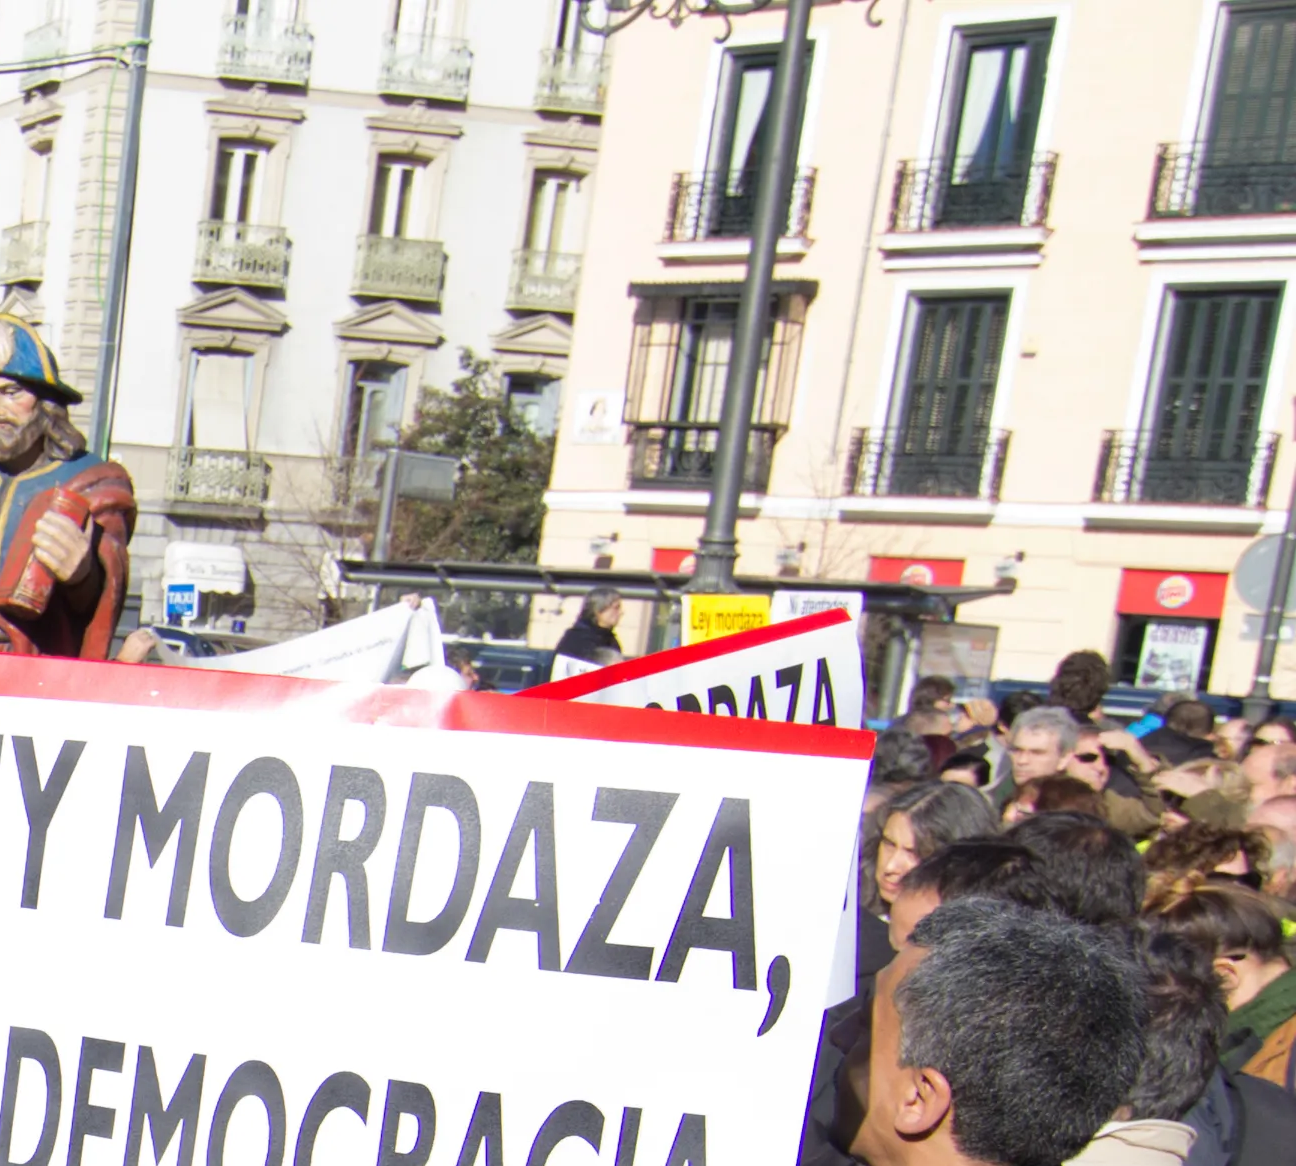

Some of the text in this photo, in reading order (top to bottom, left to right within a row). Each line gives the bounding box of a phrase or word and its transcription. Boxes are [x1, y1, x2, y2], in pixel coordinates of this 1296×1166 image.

[167, 591, 195, 605] TAXI
[691, 606, 765, 638] Ley mordaza
[104, 743, 792, 1037] MORDAZA,
